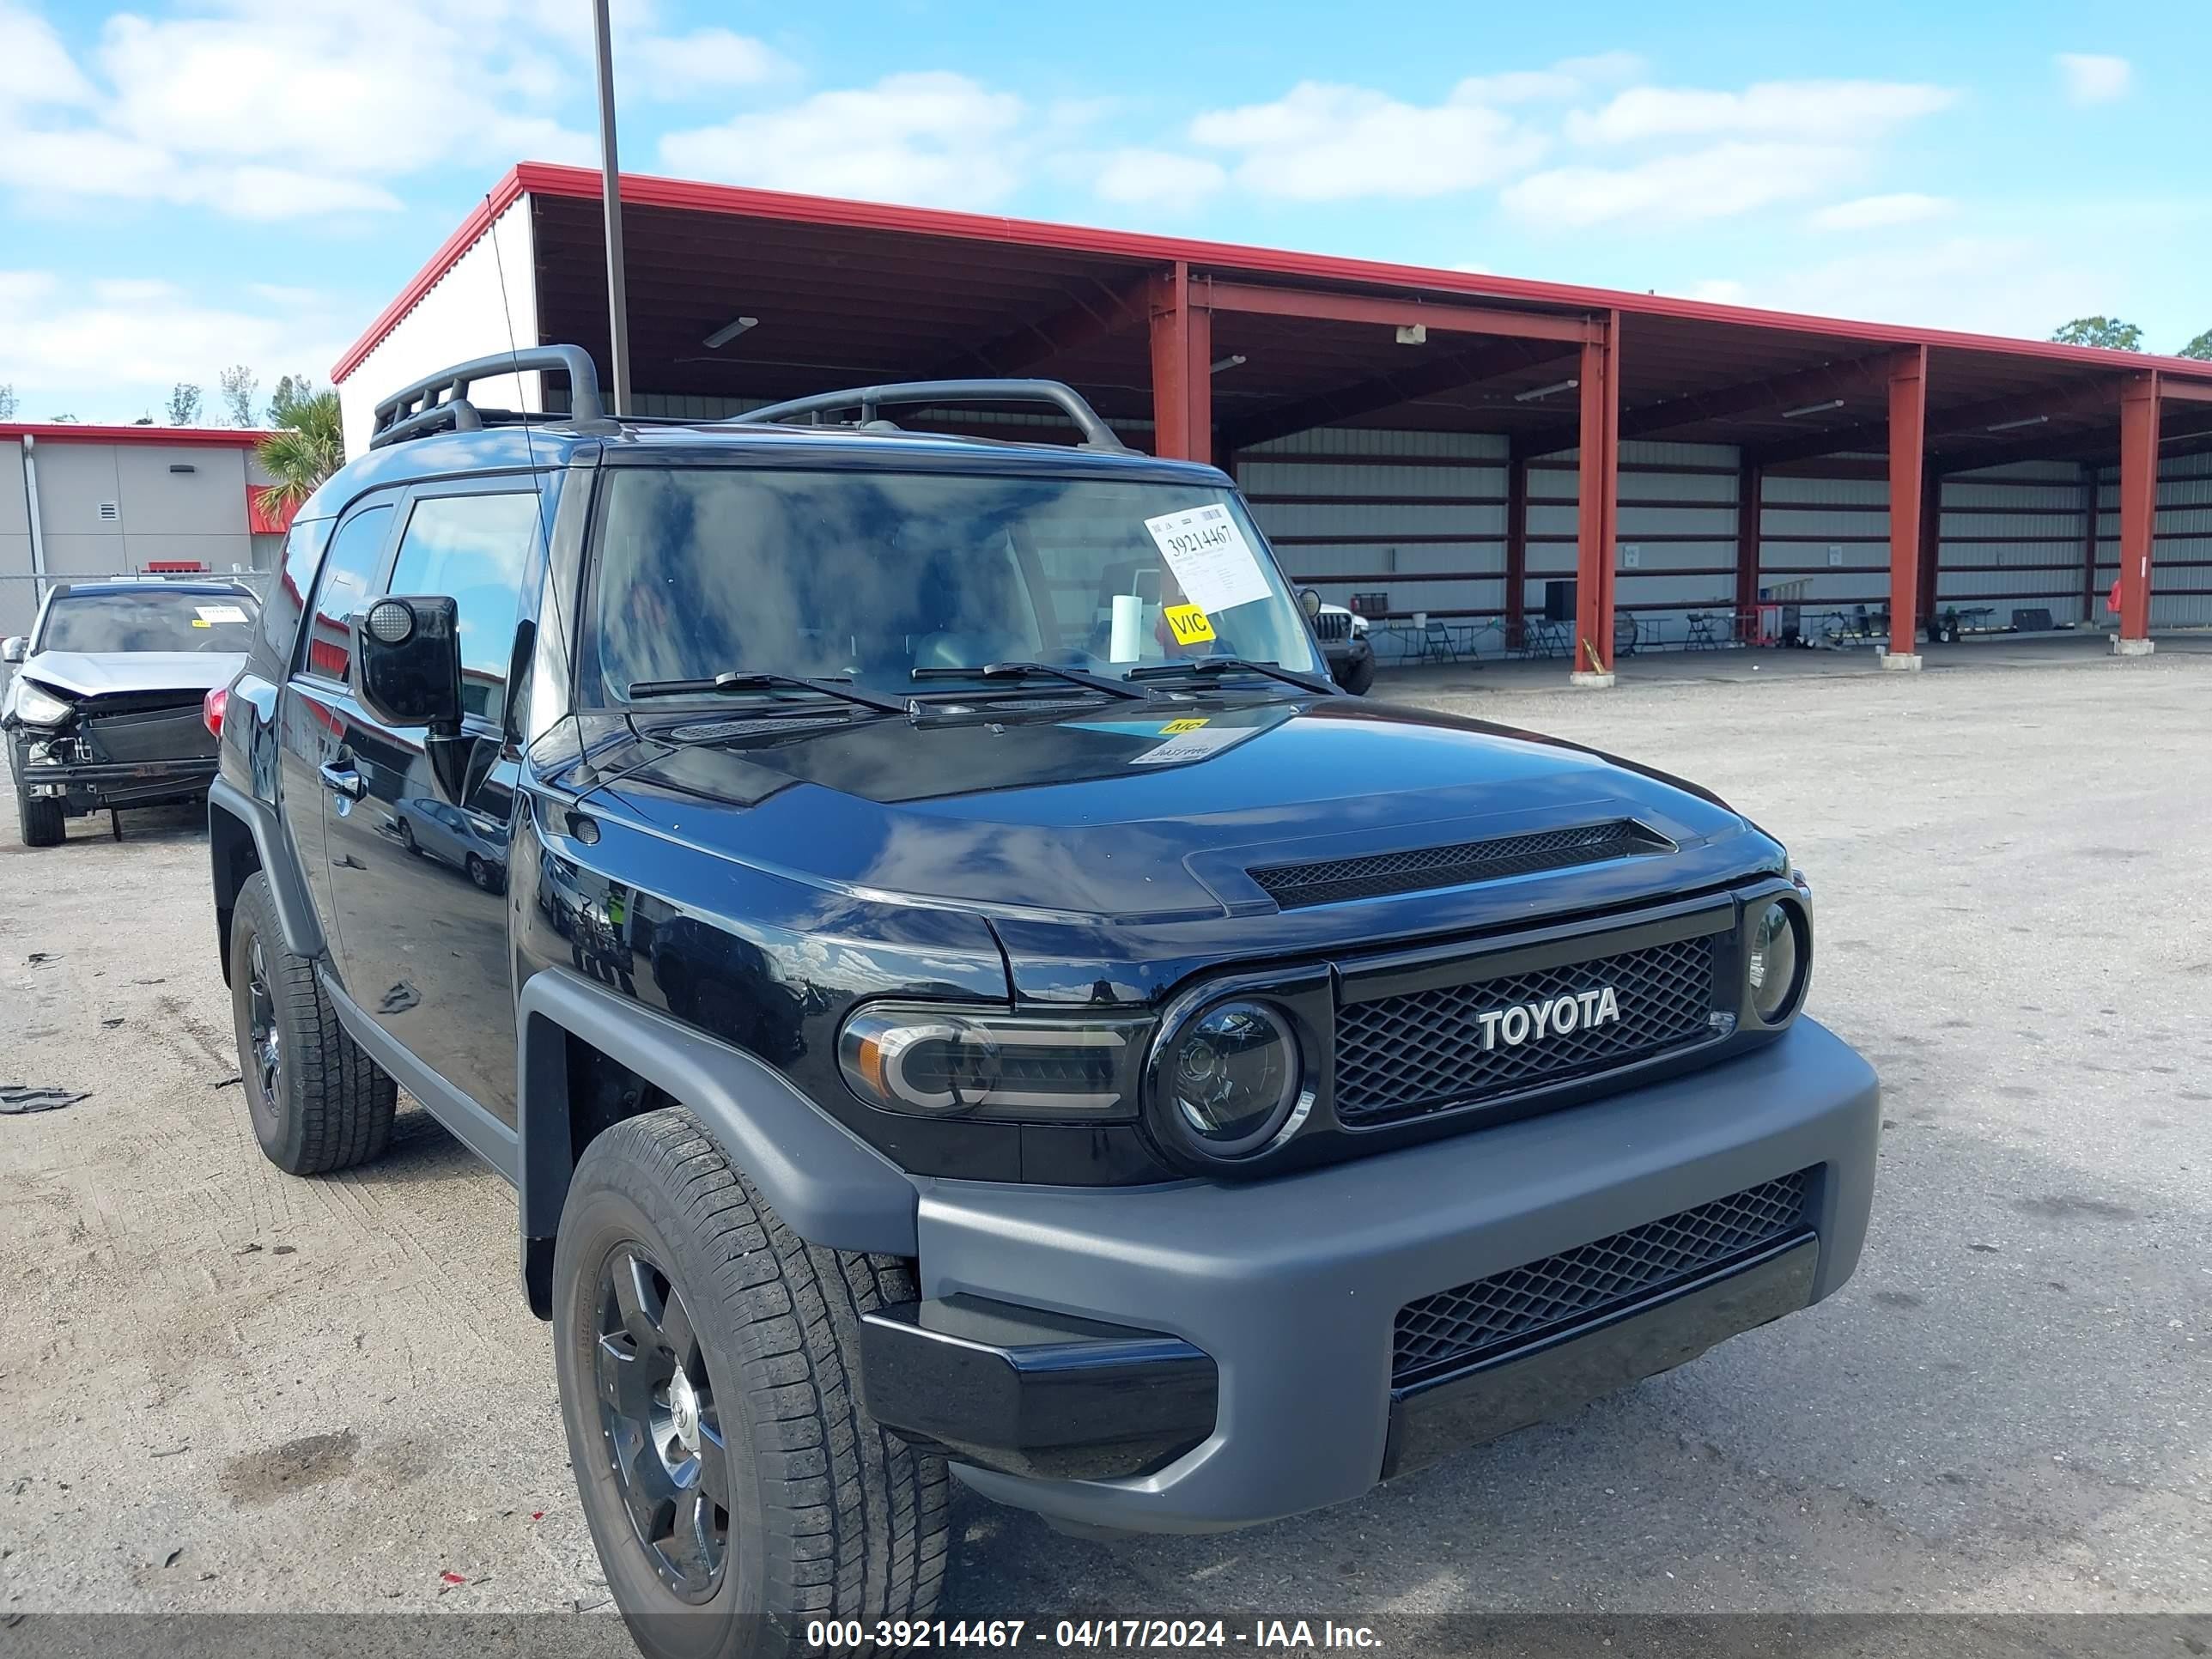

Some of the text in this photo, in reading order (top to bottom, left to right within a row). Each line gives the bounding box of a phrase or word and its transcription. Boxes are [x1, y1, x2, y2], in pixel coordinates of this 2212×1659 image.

[1167, 525, 1233, 557] 39214467
[1171, 613, 1207, 635] VIC
[1477, 986, 1620, 1051] TOYOTA
